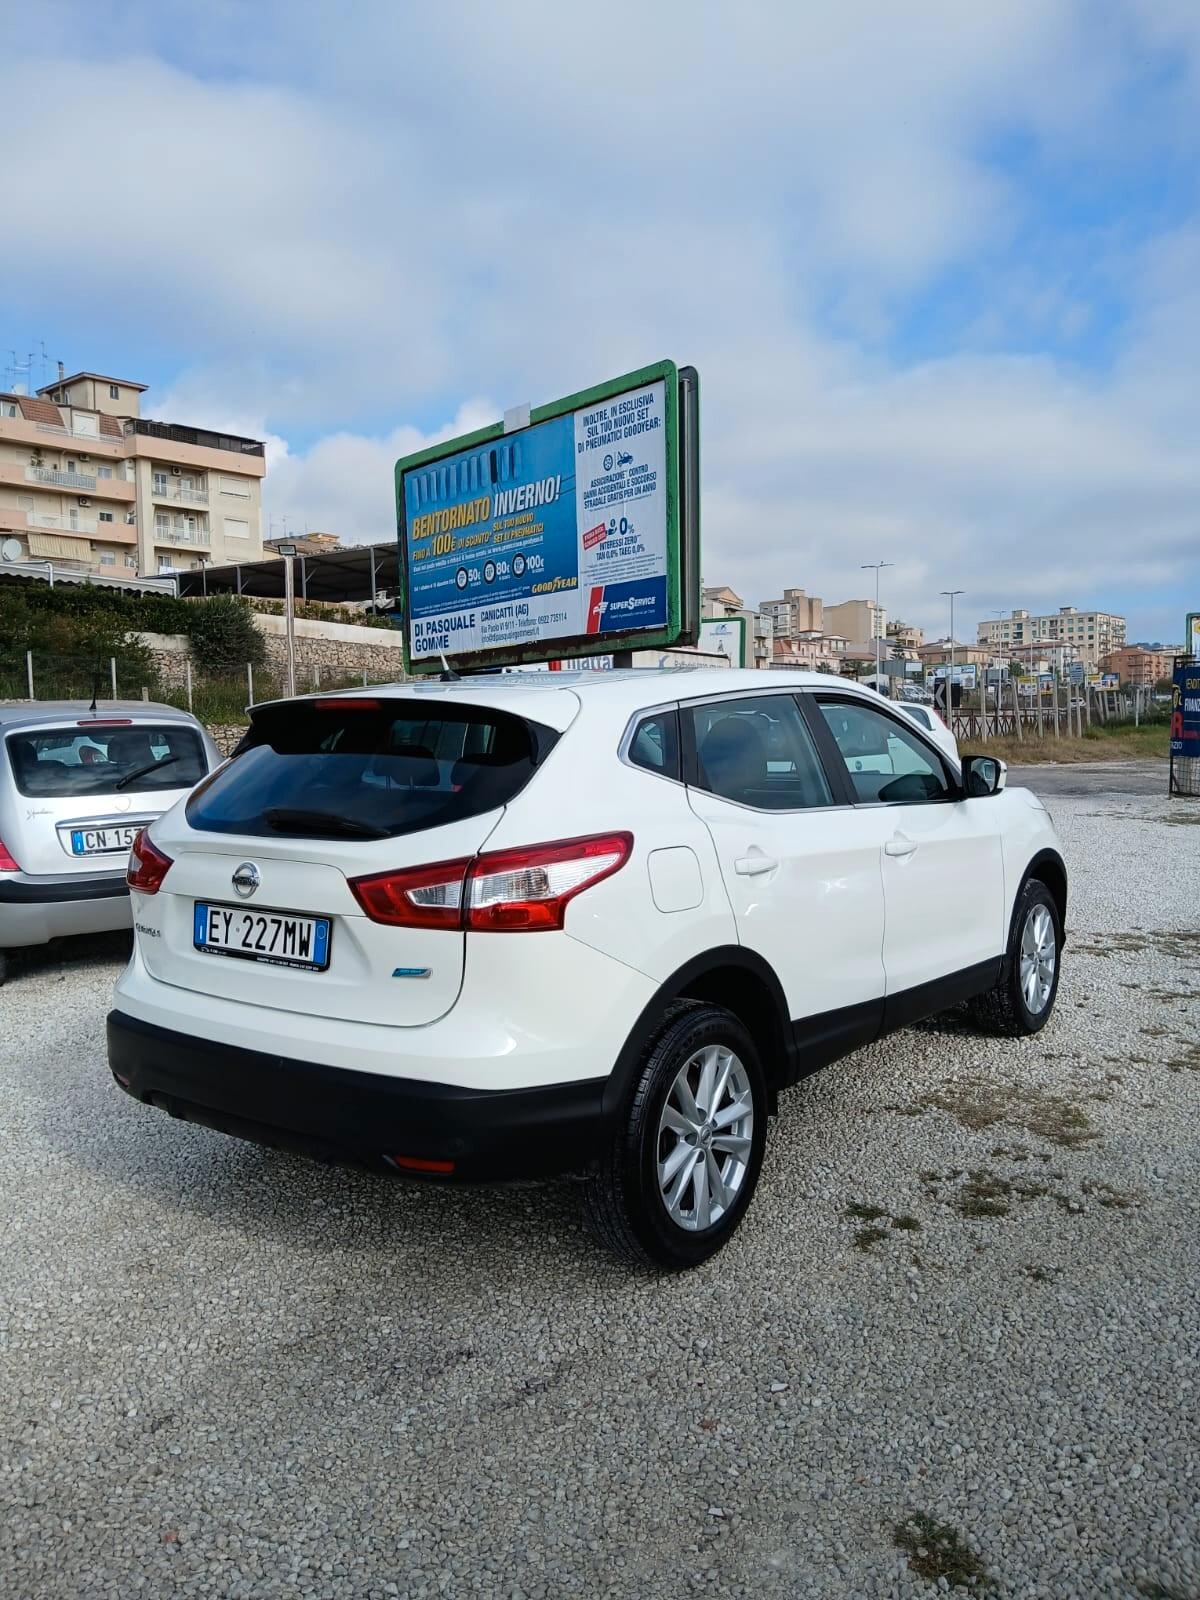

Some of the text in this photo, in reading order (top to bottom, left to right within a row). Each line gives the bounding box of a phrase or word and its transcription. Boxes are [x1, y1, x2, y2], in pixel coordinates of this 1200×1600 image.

[583, 393, 654, 427] INOLTRE, IN ESCLUSIVA
[587, 407, 649, 438] SUL TUO NUOVO SET
[578, 416, 661, 454] DI PNEUMATICI GOODYEAR:
[629, 464, 648, 477] CONTRO
[598, 481, 626, 495] ACCIDENTALI
[627, 479, 631, 488] E
[631, 472, 656, 486] SOCCORSO
[584, 496, 606, 510] STRADALE
[608, 490, 624, 502] GRATIS
[624, 488, 634, 498] PER
[634, 486, 642, 496] UN
[642, 481, 656, 493] ANNO
[412, 474, 562, 541] BENTORNATO INVERNO!
[493, 521, 503, 532] SUL
[494, 534, 504, 544] SET
[510, 522, 544, 538] PNEUMATICI
[413, 549, 426, 561] FINO
[432, 533, 456, 556] 100€
[596, 551, 606, 560] TAN
[619, 546, 632, 556] TAEG
[600, 538, 624, 551] INTERESSI
[496, 561, 510, 576] 80€
[526, 554, 544, 570] 100€
[468, 568, 481, 582] 50€
[532, 576, 577, 594] GOODYEAR
[516, 604, 529, 618] (AG)
[414, 614, 476, 637] DI PASQUALE
[488, 624, 499, 632] Paolo
[538, 616, 550, 624] 0922
[416, 635, 450, 652] GOMME
[85, 832, 106, 849] CN
[208, 910, 234, 944] EY
[242, 915, 312, 958] 227MW
